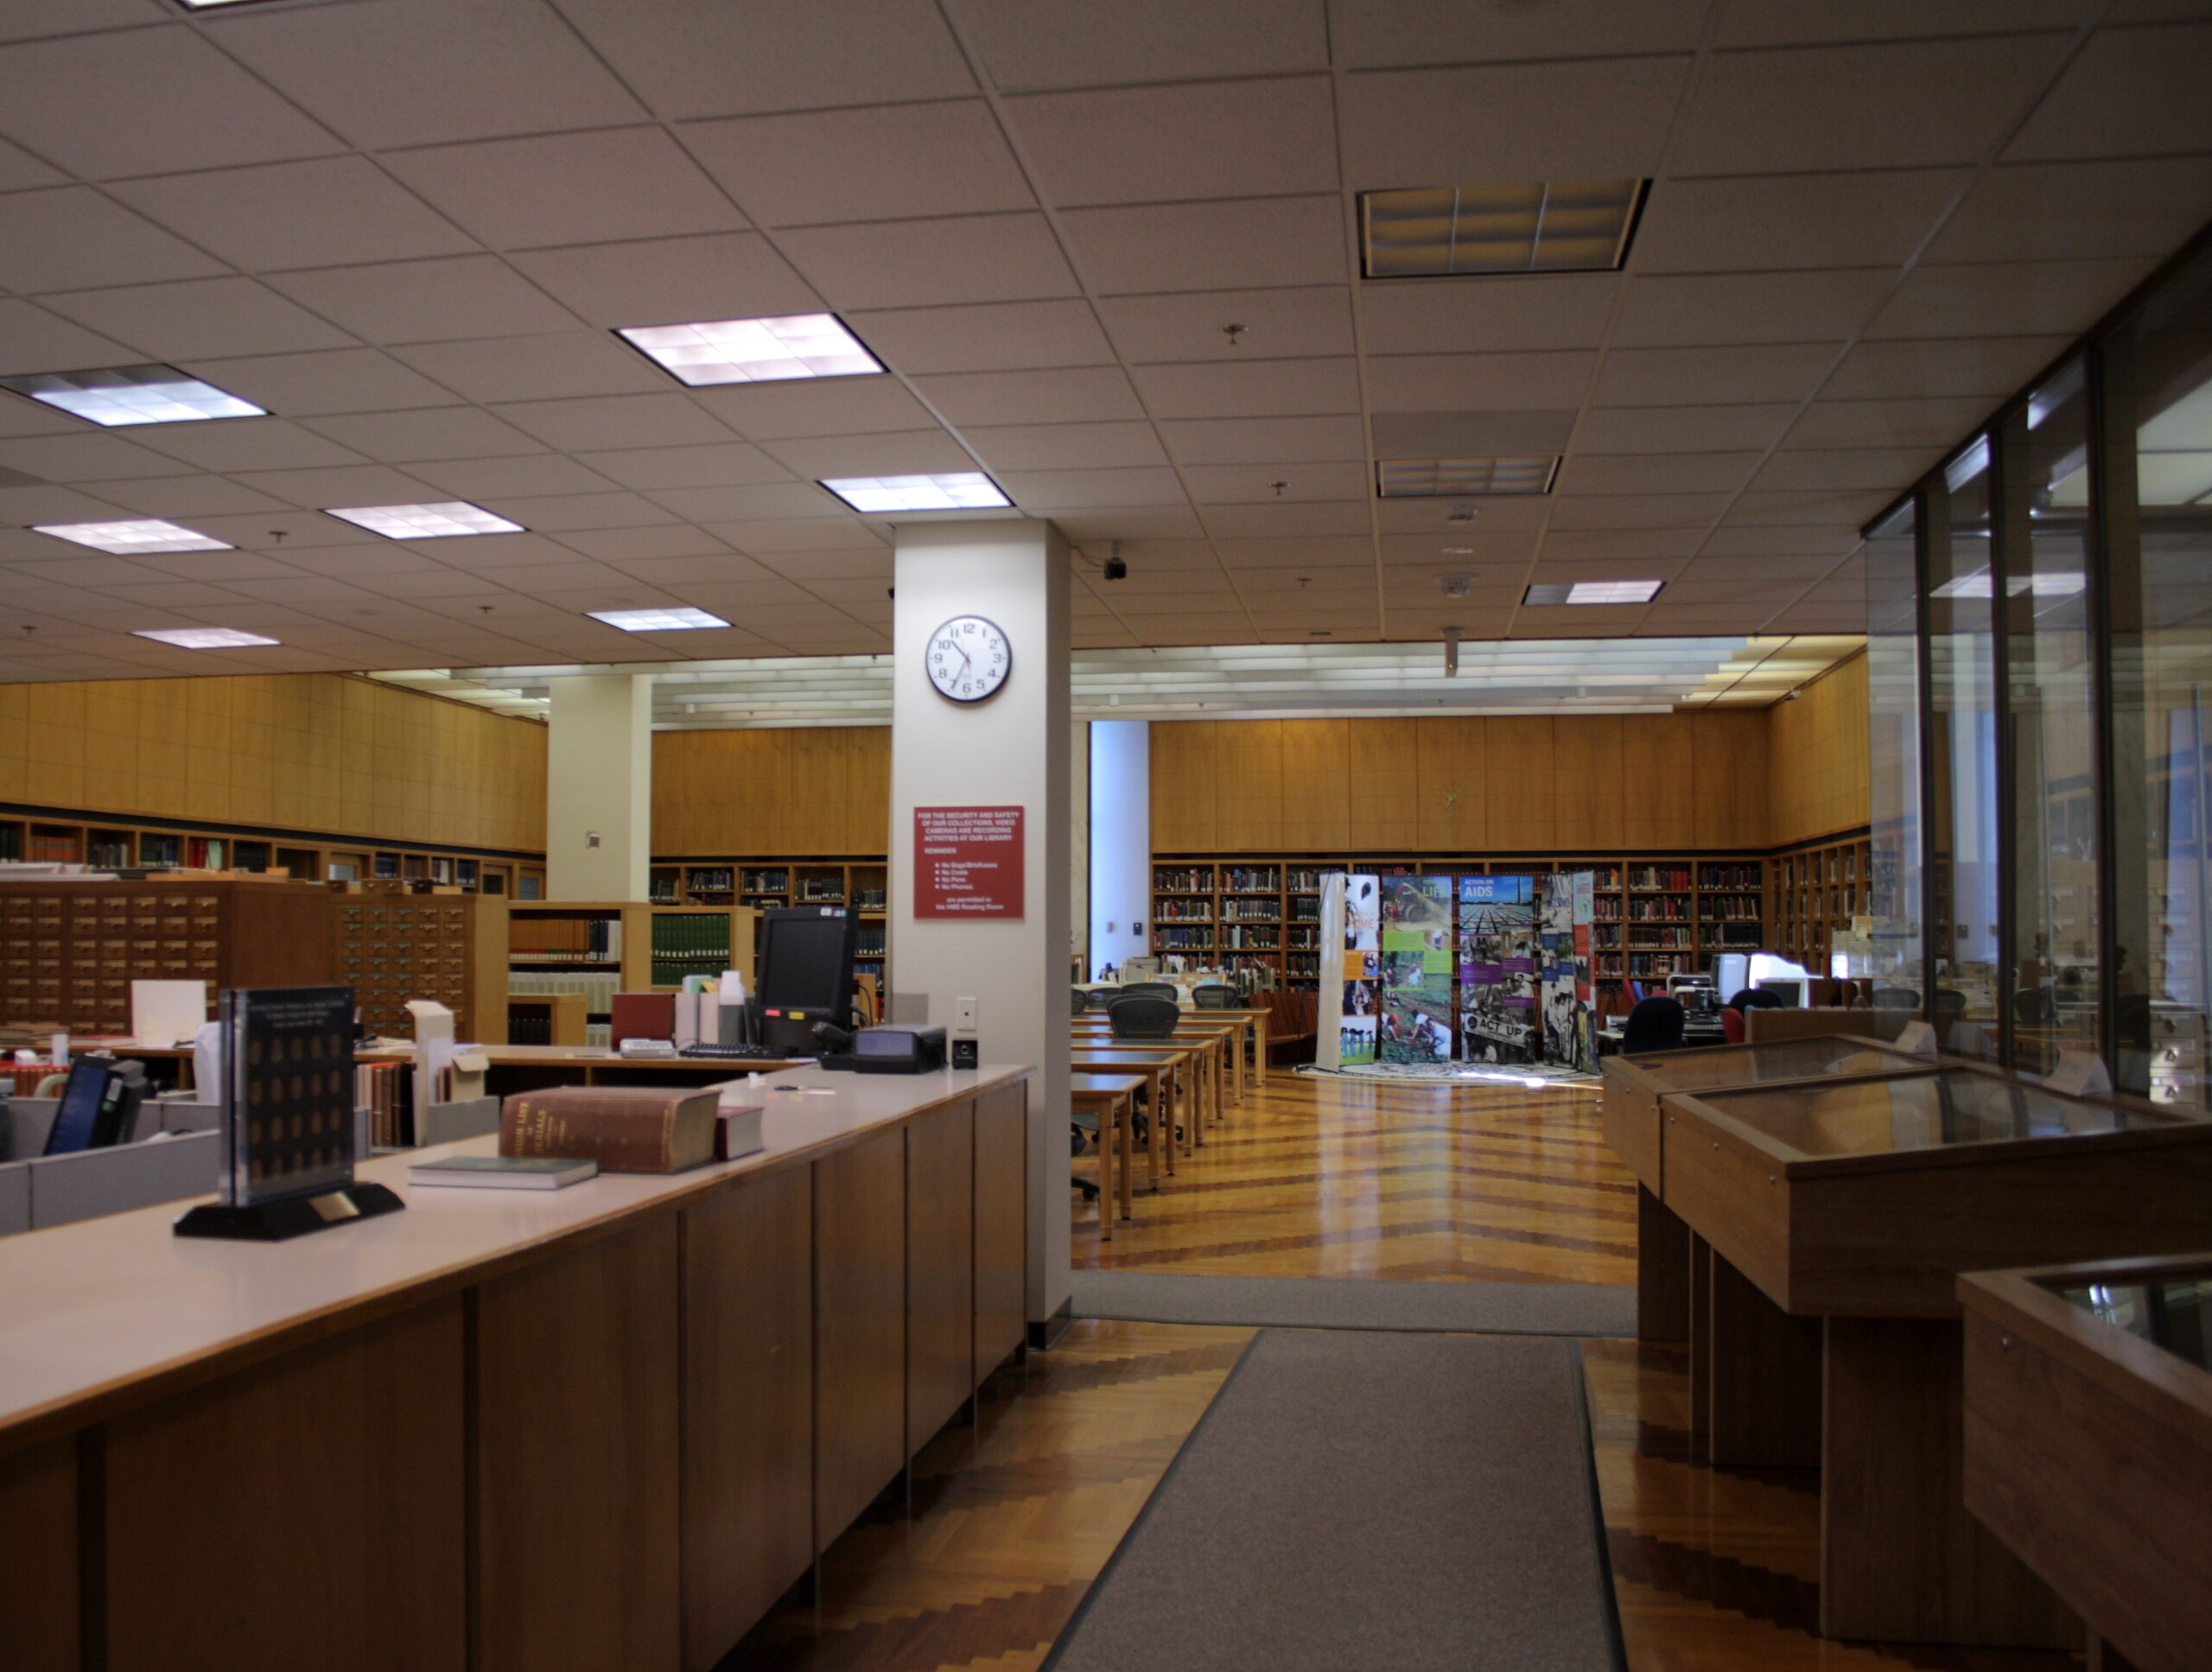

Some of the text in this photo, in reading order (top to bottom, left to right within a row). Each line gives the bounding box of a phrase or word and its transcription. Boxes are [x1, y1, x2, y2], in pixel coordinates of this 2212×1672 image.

[950, 628, 959, 638] 11
[963, 623, 976, 634] 12
[938, 639, 951, 650] 10
[988, 639, 998, 650] 2
[933, 653, 943, 664] 9
[993, 653, 1002, 664] 3
[938, 668, 948, 678] 8
[988, 669, 996, 678] 4
[962, 683, 971, 694] 6
[976, 679, 985, 690] 5
[1465, 887, 1494, 897] AIDS
[1480, 1018, 1501, 1033] ACT
[1506, 1025, 1522, 1037] UP
